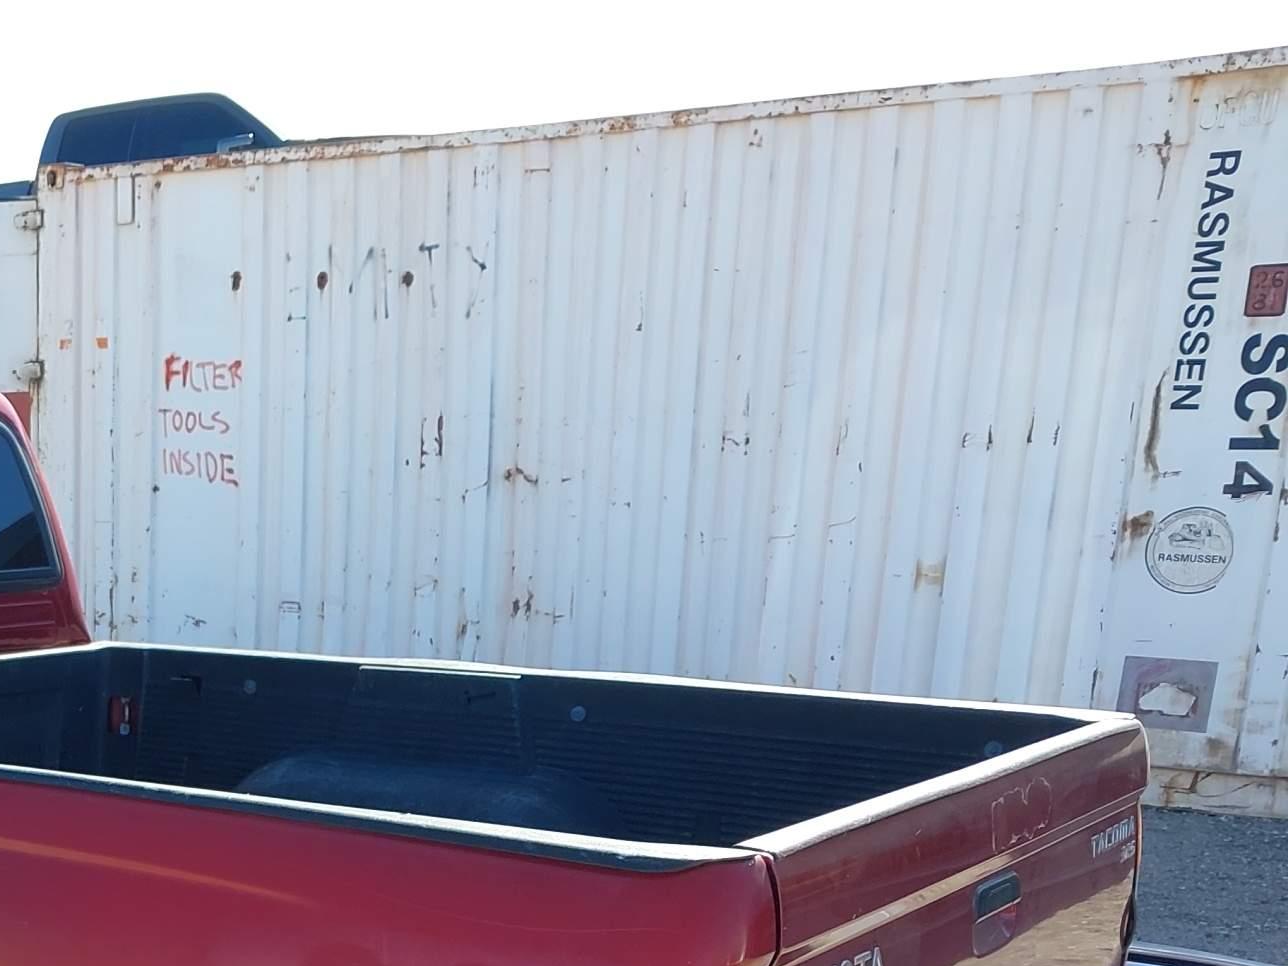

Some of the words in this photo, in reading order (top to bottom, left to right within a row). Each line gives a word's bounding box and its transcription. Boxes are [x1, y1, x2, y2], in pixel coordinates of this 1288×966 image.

[1169, 149, 1242, 410] RASMUSSEN
[164, 354, 243, 392] FILTER
[158, 408, 230, 438] TOOLS
[1222, 332, 1288, 499] SC14
[163, 448, 239, 487] INSIDE
[1158, 552, 1227, 564] RASMUSSEN
[1090, 815, 1136, 859] TACOMA
